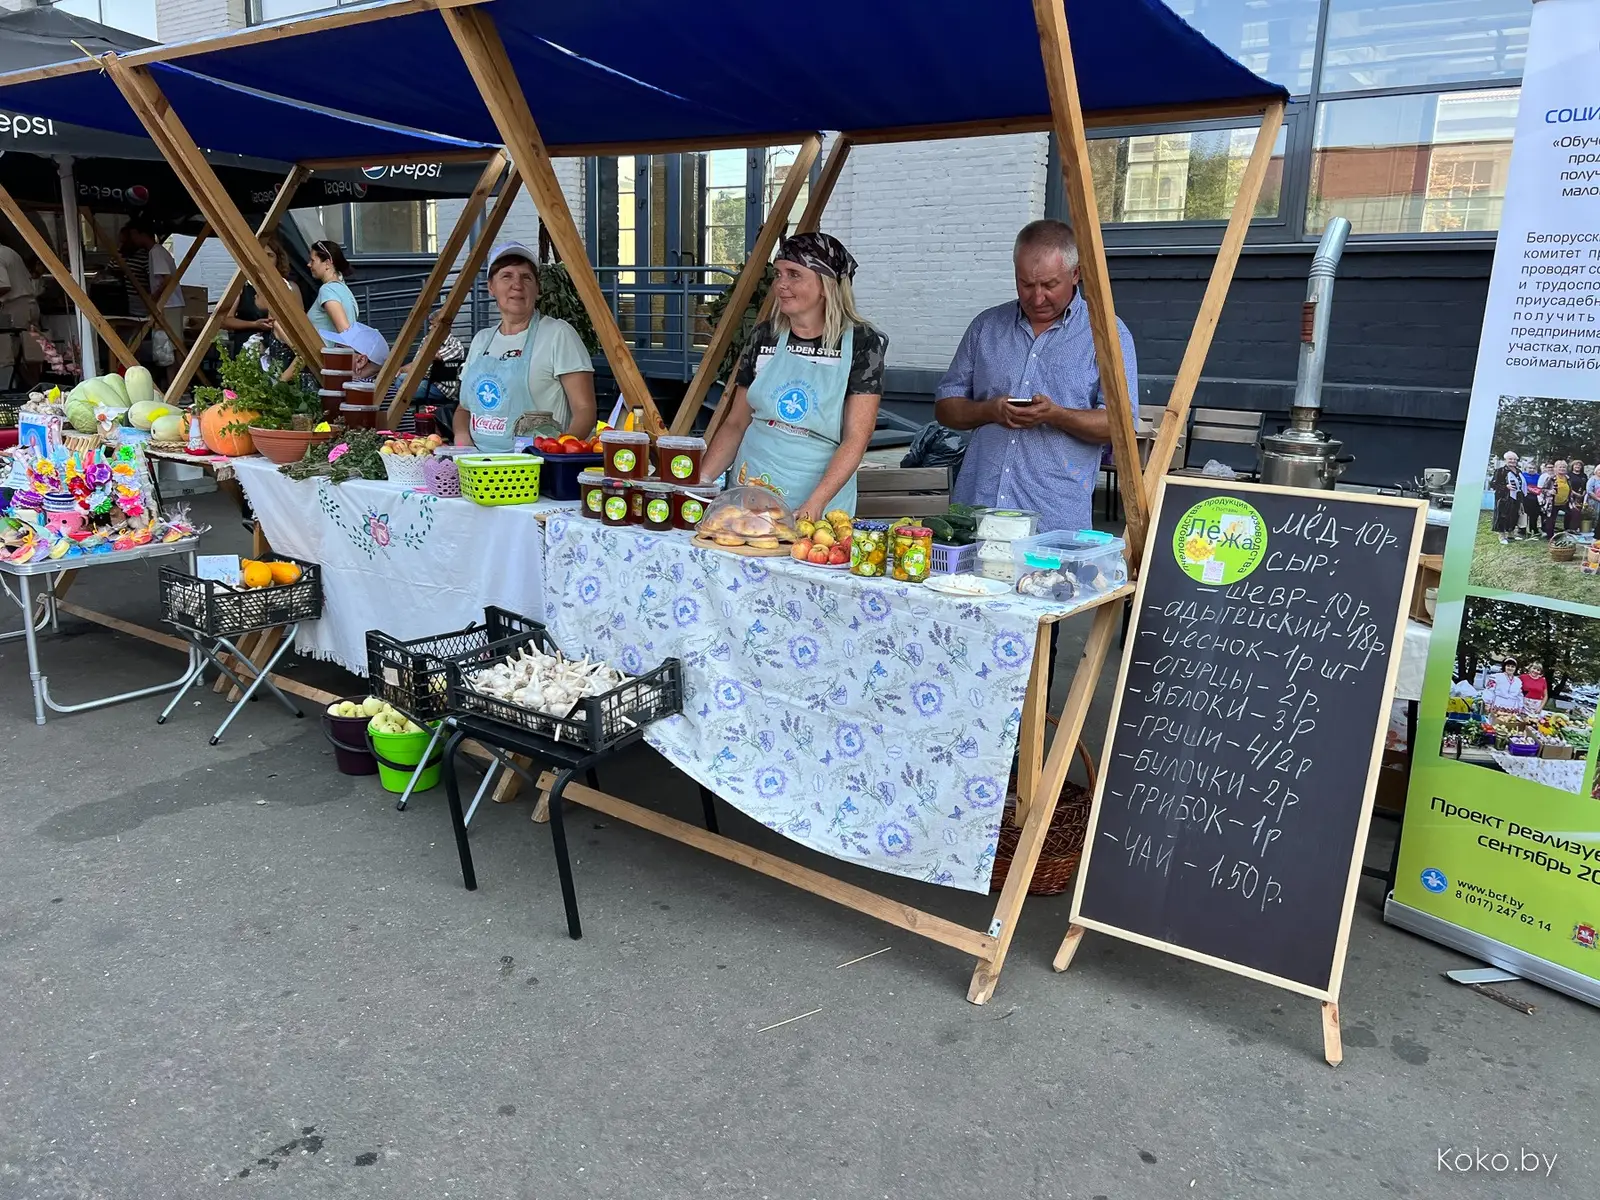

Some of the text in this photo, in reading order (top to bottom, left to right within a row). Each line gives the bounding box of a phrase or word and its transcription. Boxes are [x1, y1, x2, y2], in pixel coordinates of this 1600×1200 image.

[1523, 249, 1581, 259] комитет
[1521, 265, 1586, 276] проводят
[1519, 281, 1600, 292] и трудоспо
[1513, 312, 1595, 323] получить
[786, 345, 815, 355] OLDEN
[1508, 342, 1571, 354] участках,
[1506, 356, 1537, 366] свой
[1539, 357, 1585, 369] малый
[1186, 518, 1253, 550] Лёжа
[1431, 796, 1504, 829] Проект
[1477, 835, 1572, 875] сентябрь
[1457, 880, 1524, 910] www.bcf.by
[1455, 890, 1552, 932] 8 (017) 247 62 14
